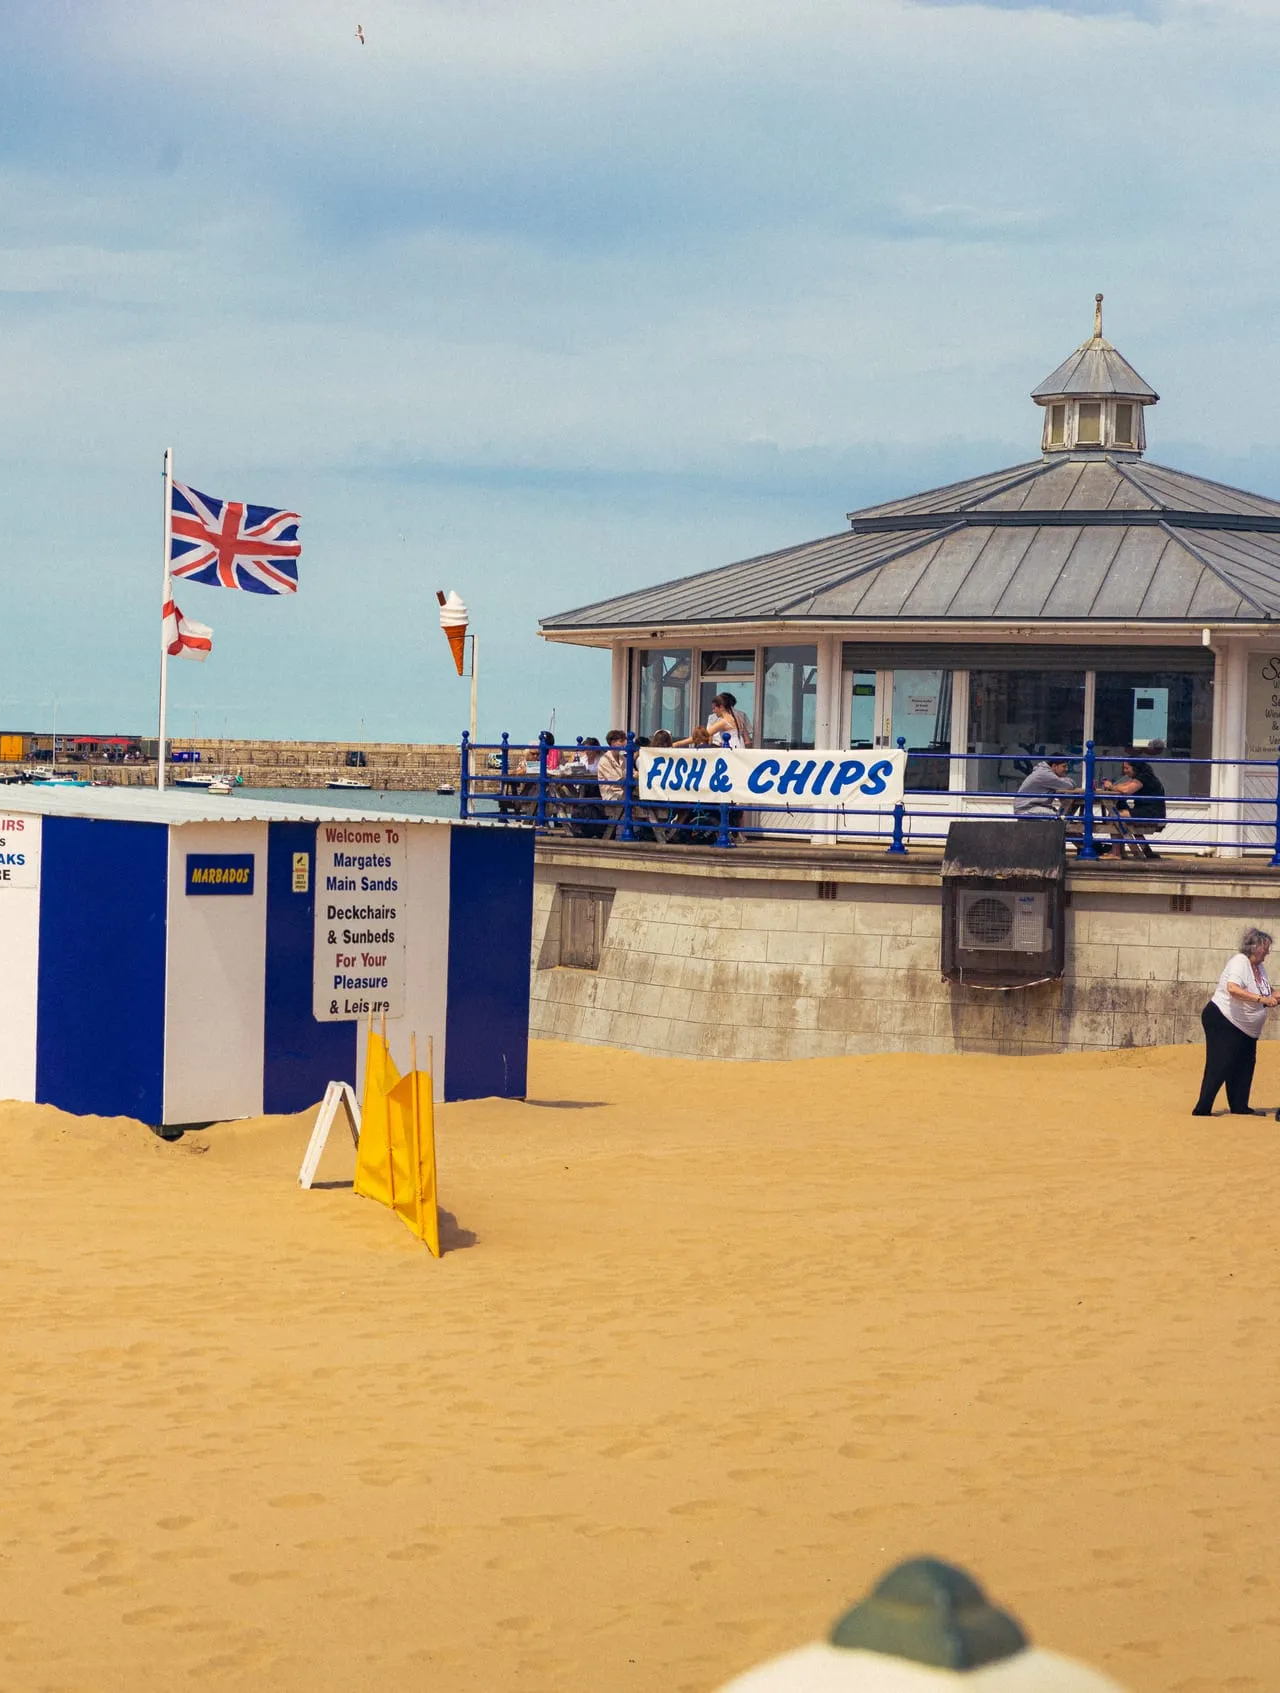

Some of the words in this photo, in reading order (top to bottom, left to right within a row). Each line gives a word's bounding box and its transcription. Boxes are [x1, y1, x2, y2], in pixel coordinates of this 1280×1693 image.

[646, 756, 707, 792] FISH
[708, 757, 733, 793] &
[747, 758, 893, 796] CHIPS
[325, 827, 381, 844] Welcome
[385, 829, 399, 844] To
[333, 852, 392, 870] Margates
[191, 867, 250, 884] MARBADOS
[326, 876, 356, 891] Main
[361, 876, 398, 891] Sands
[327, 904, 397, 920] Deckchairs
[327, 929, 337, 944] &
[343, 928, 395, 944] Sunbeds
[335, 953, 357, 968] For
[361, 952, 387, 967] Your
[333, 974, 388, 990] Pleasure
[329, 999, 339, 1014] &
